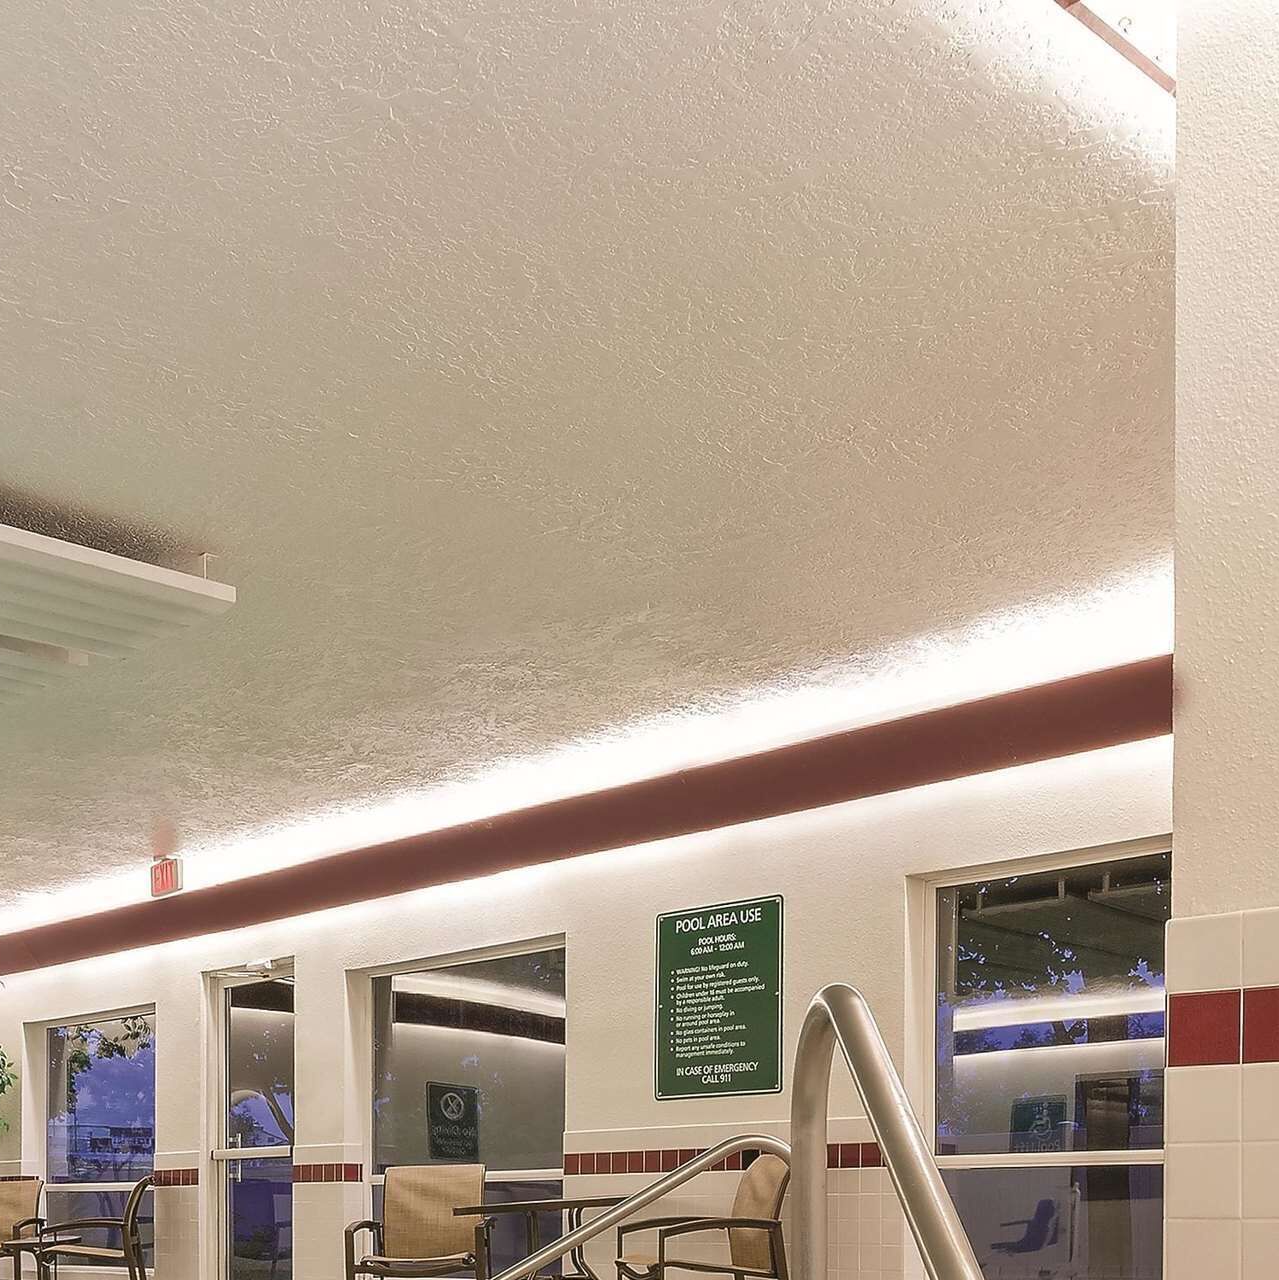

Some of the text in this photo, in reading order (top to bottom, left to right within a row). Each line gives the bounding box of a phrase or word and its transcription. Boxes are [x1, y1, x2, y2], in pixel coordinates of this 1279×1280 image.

[153, 860, 174, 893] EXIT
[675, 907, 762, 934] POOL AREA USE
[698, 936, 714, 946] POOL
[702, 945, 713, 953] AM
[733, 941, 745, 949] AM
[676, 1061, 759, 1076] IN CASE OF EMERGENCY
[701, 1073, 731, 1084] CALL 911
